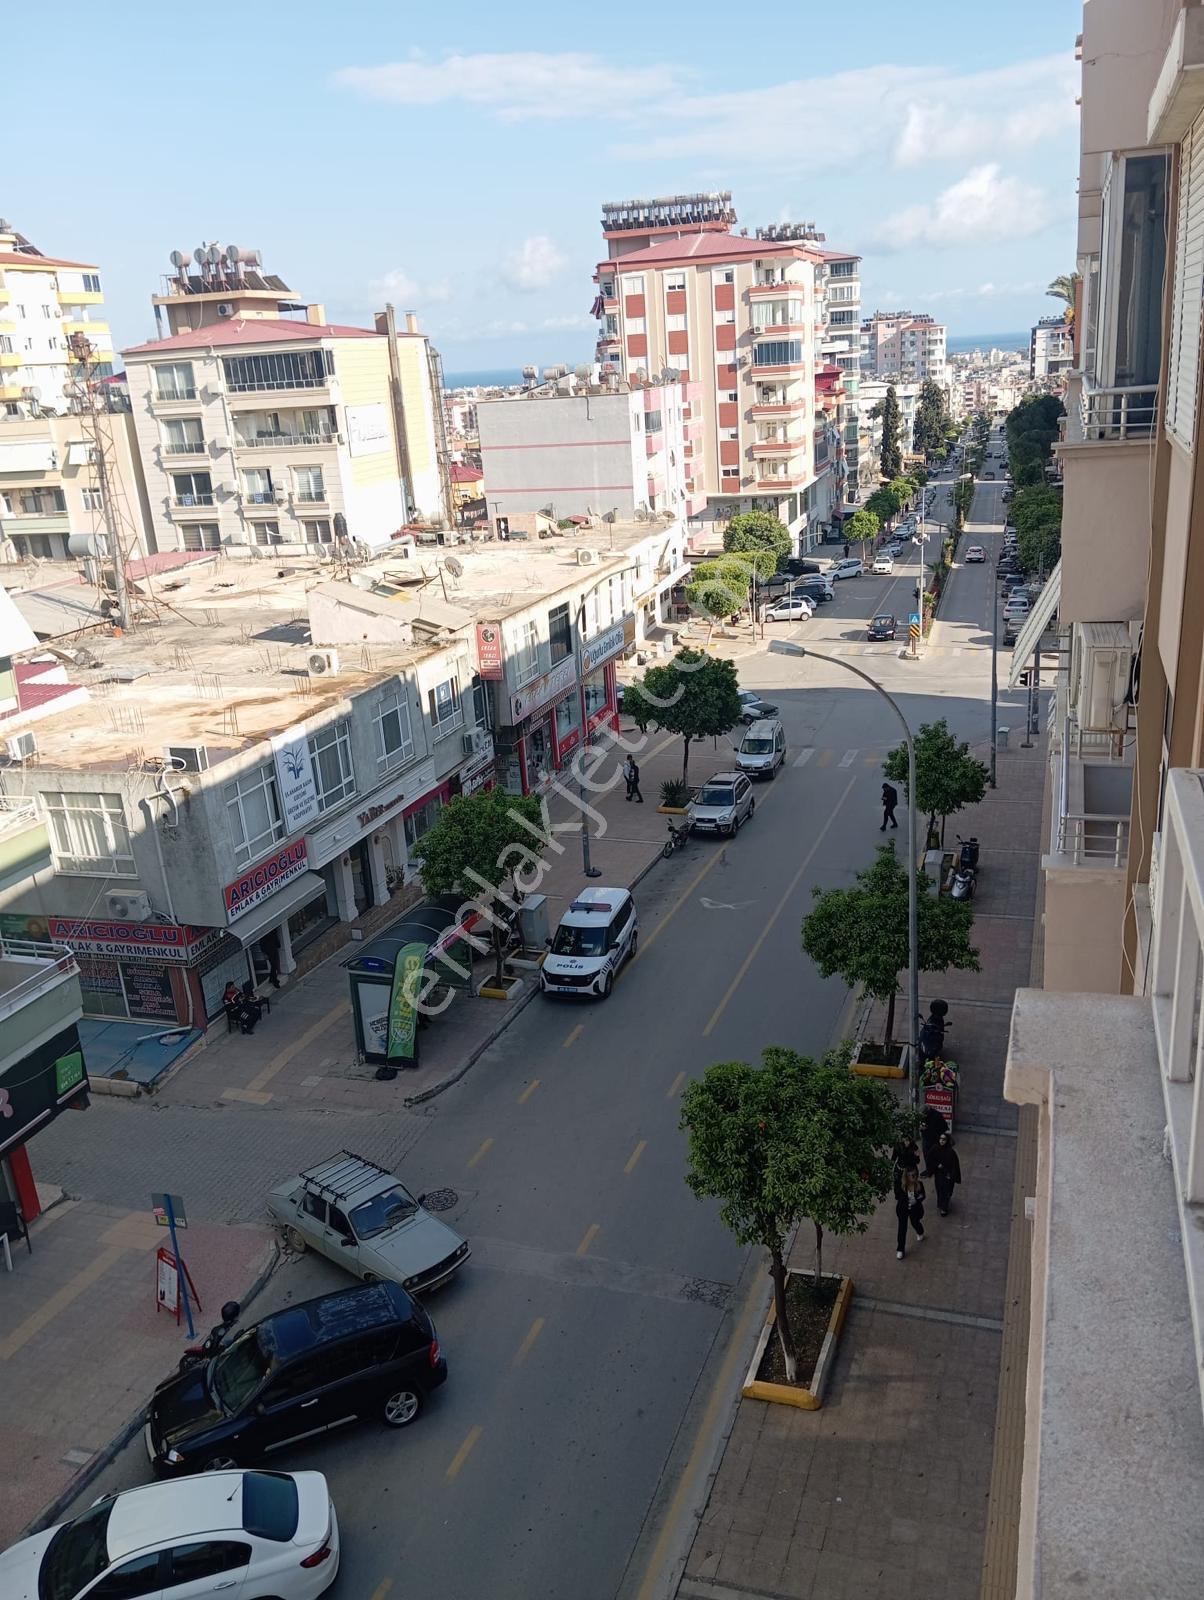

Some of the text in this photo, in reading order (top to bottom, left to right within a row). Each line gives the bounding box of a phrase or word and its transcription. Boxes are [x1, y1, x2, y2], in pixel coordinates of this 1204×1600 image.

[231, 844, 304, 906] ARICIOĞLU
[230, 896, 255, 917] EMLAK
[55, 921, 178, 943] ARICIOĞLU
[96, 943, 104, 951] &
[190, 934, 217, 955] EMLAK
